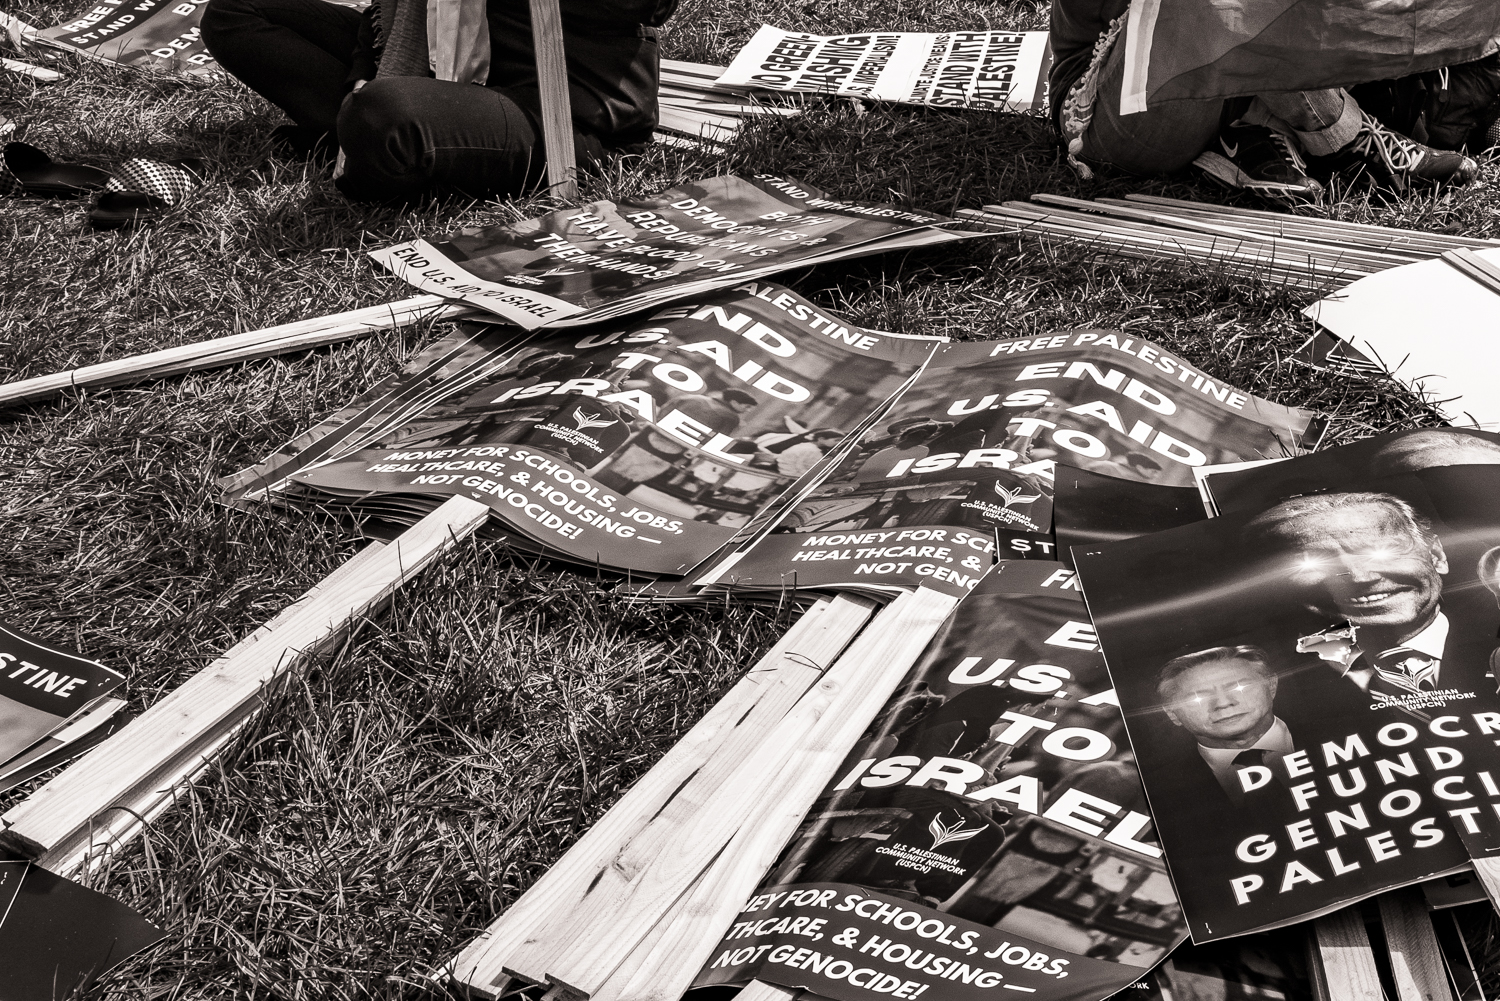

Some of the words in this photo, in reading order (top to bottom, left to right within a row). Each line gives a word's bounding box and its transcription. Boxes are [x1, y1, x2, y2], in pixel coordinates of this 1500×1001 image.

[62, 6, 110, 33] FREE
[72, 12, 135, 45] STAND
[946, 33, 987, 63] WITH
[929, 64, 976, 107] STAND
[648, 304, 797, 357] END
[574, 327, 671, 350] U.S.
[677, 339, 813, 402] AID
[617, 352, 706, 392] TO
[989, 335, 1068, 357] FREE
[1072, 332, 1249, 411] PALESTINE
[1014, 361, 1178, 416] END
[490, 377, 746, 464] ISRAEL
[946, 389, 1055, 417] U.S.
[1066, 400, 1208, 466] AID
[1009, 417, 1112, 459] TO
[366, 462, 505, 477] HEALTHCARE,
[509, 471, 531, 486] &
[531, 479, 636, 539] HOUSING
[383, 446, 464, 461] MONEY
[461, 446, 510, 458] FOR
[509, 449, 618, 513] SCHOOLS,
[620, 507, 685, 535] JOBS,
[410, 474, 464, 486] NOT
[462, 476, 584, 541] GENOCIDE!
[947, 656, 1072, 698] U.S.
[994, 711, 1112, 761] TO
[1289, 746, 1465, 812] FUND
[833, 755, 1164, 859] ISRAEL
